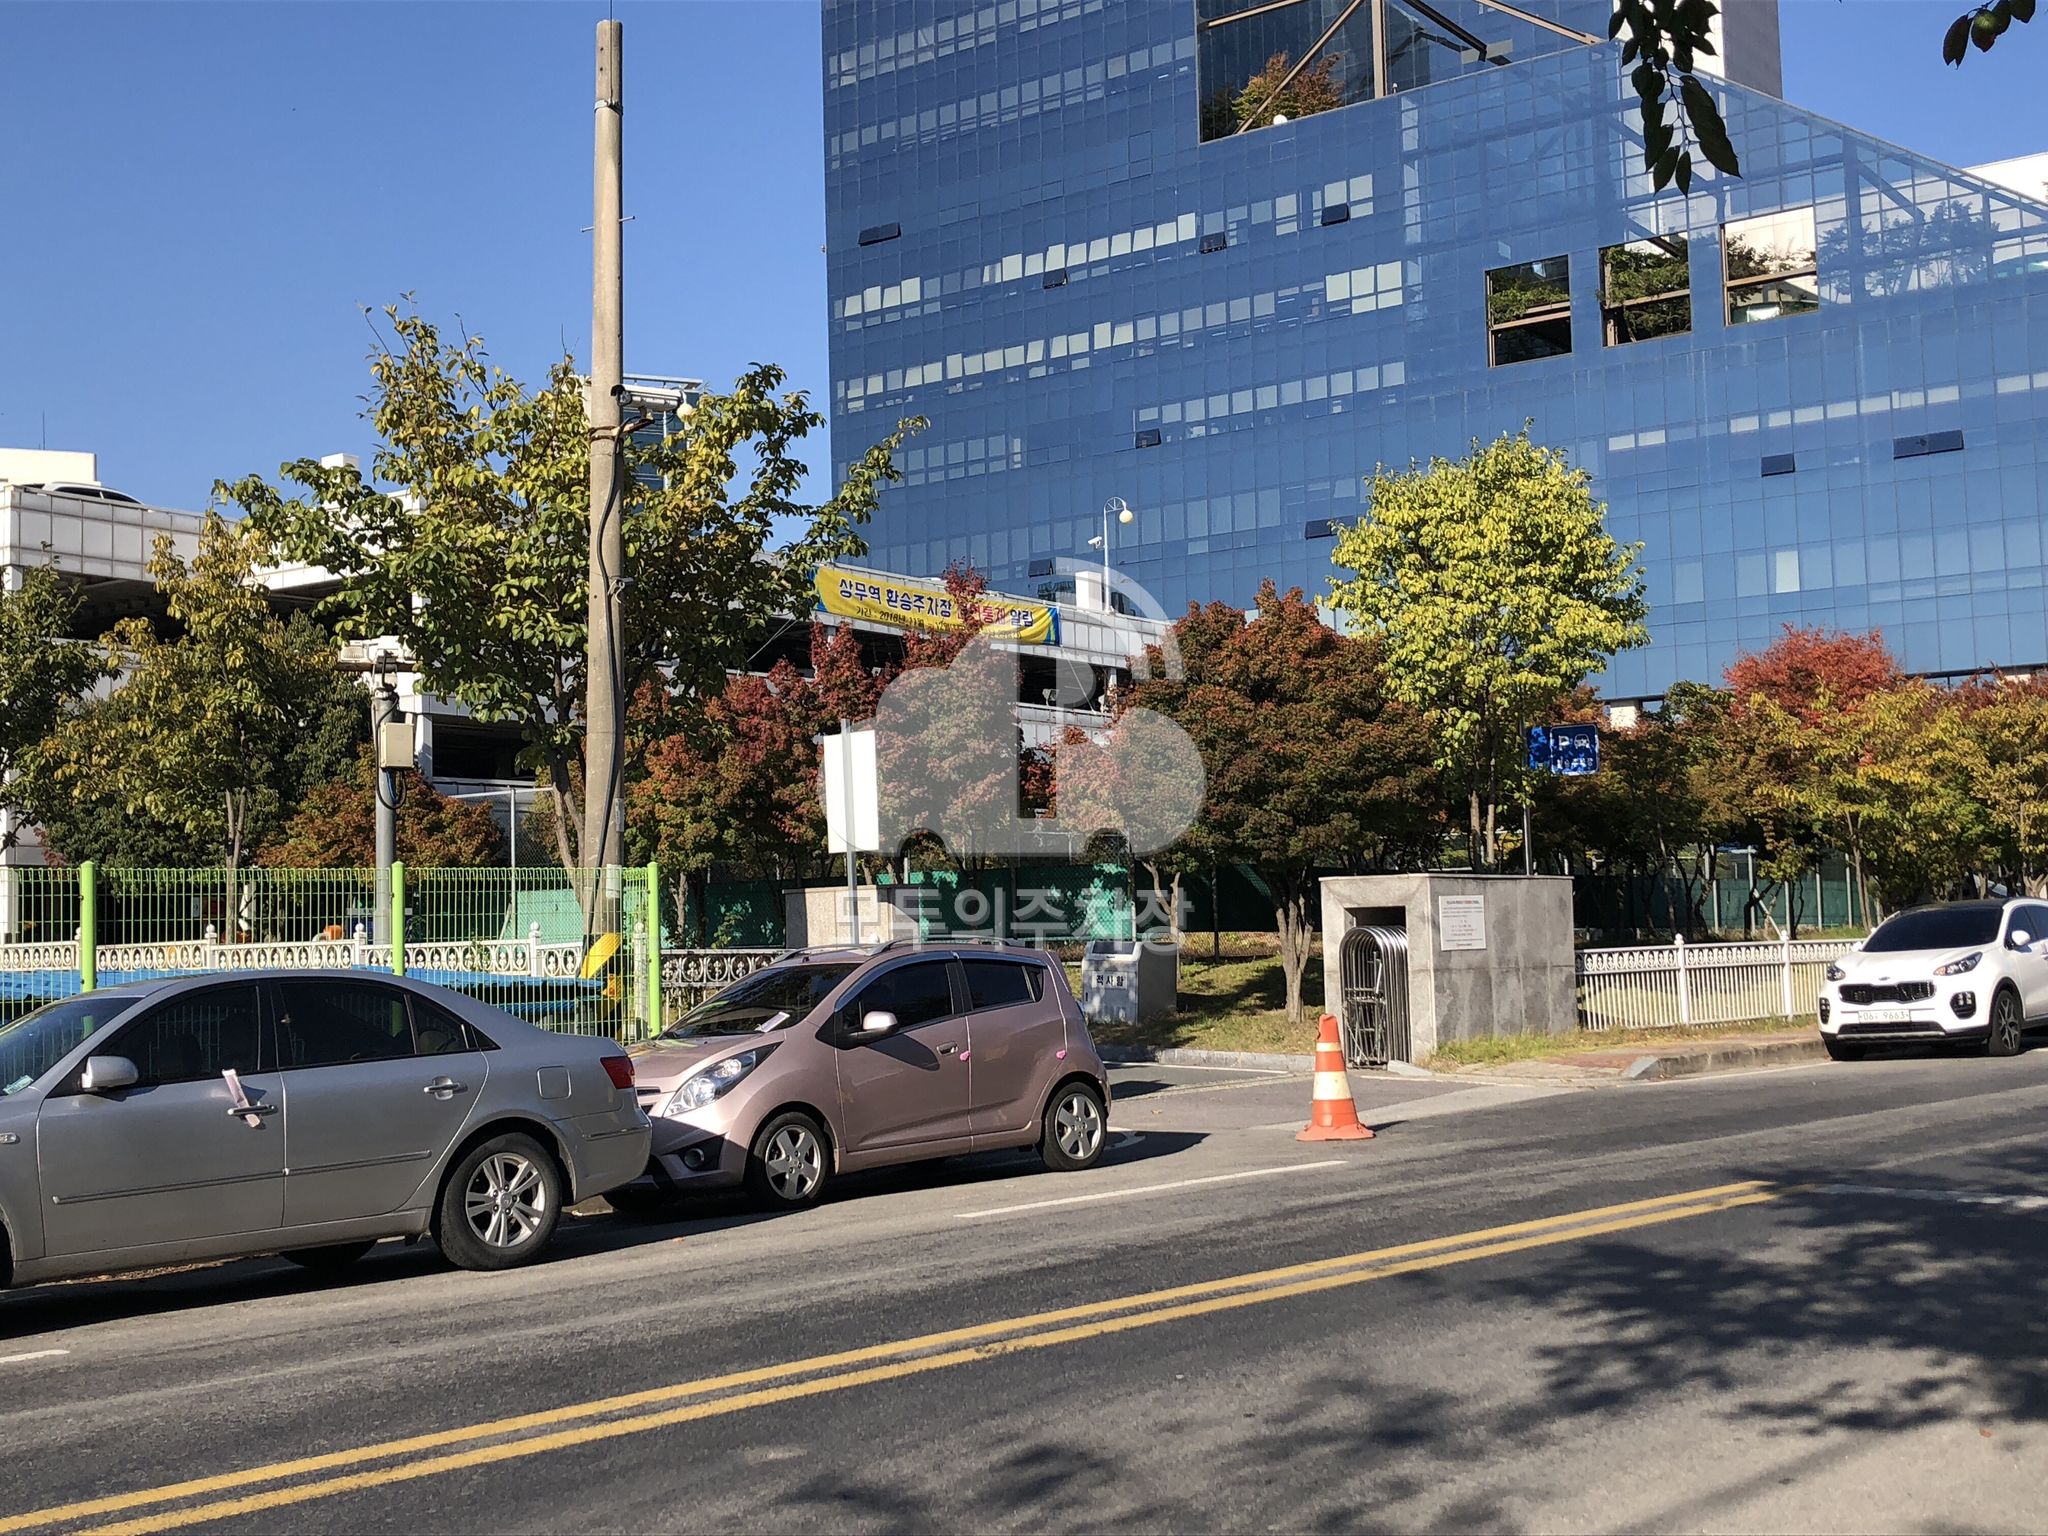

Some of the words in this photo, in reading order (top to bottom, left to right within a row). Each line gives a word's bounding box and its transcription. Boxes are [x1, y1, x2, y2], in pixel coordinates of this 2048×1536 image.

[839, 578, 882, 604] 상무역
[885, 587, 952, 618] 환승주차장
[1010, 608, 1034, 627] 알림
[1558, 735, 1570, 751] P
